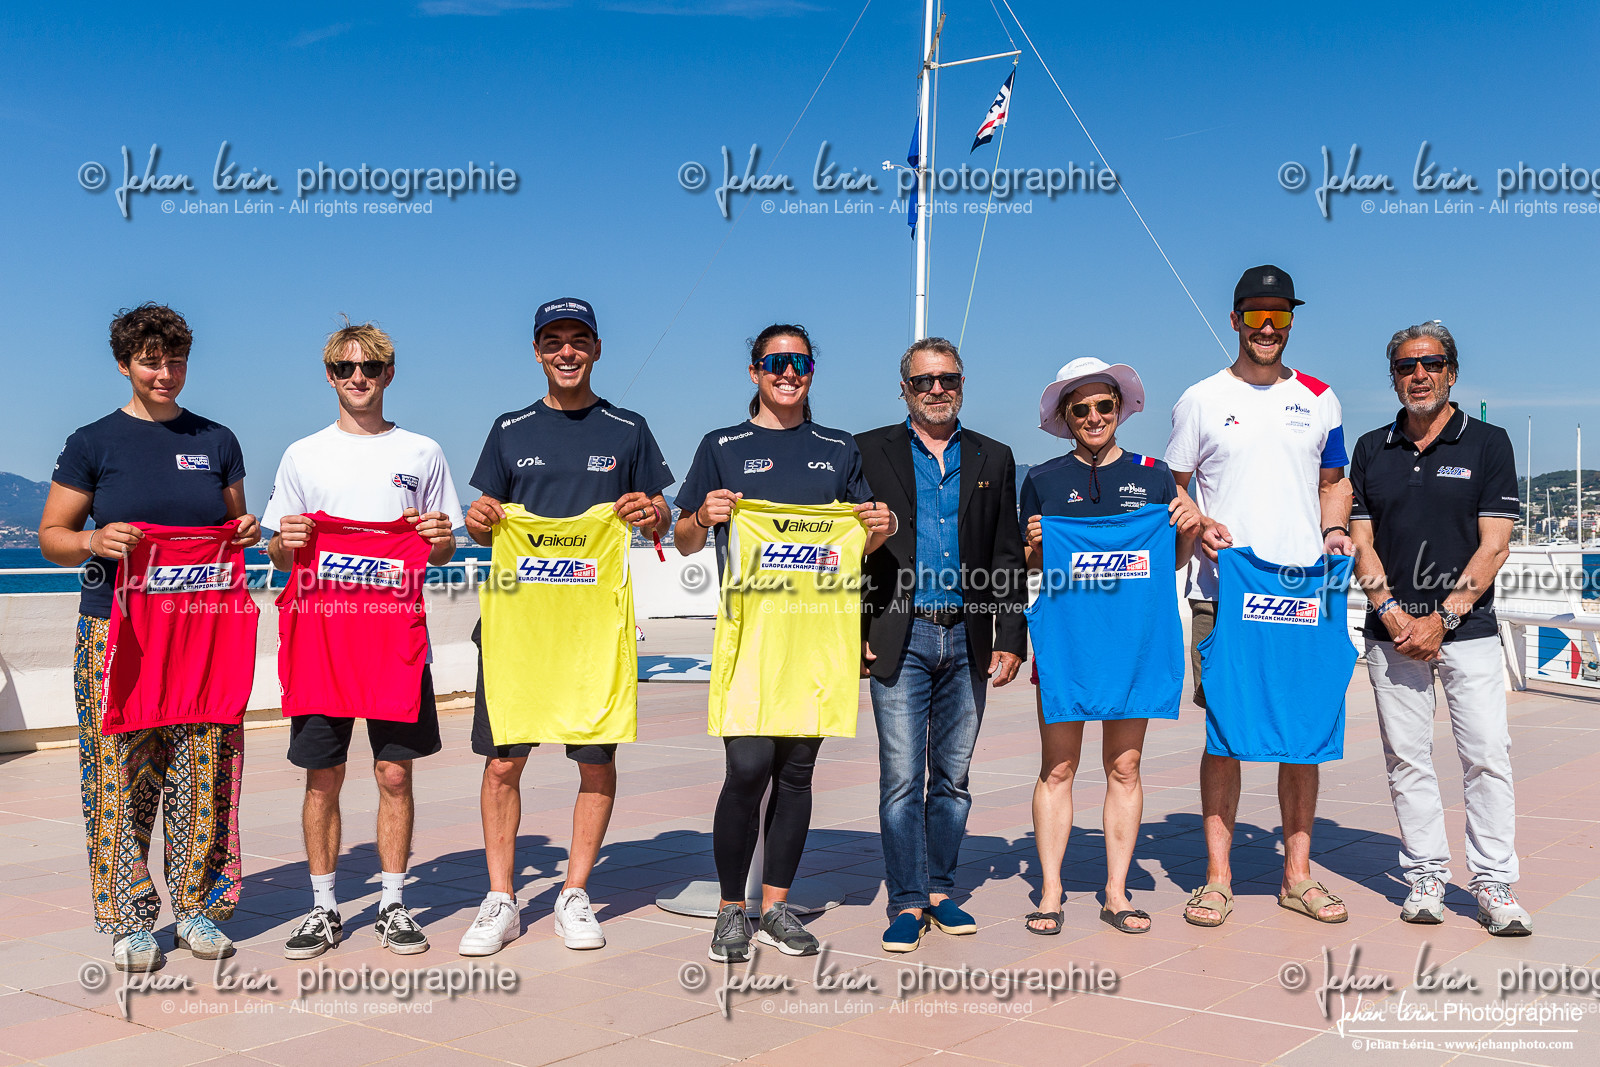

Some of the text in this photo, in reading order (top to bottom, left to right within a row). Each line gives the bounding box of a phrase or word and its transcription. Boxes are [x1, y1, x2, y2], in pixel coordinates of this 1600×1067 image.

[588, 456, 613, 467] ESP
[744, 459, 770, 469] ESP
[772, 519, 834, 533] Vaikobi
[527, 533, 587, 547] Vaikobi
[319, 572, 351, 580] EUROPEAN
[352, 575, 400, 585] CHAMPIONSHIP
